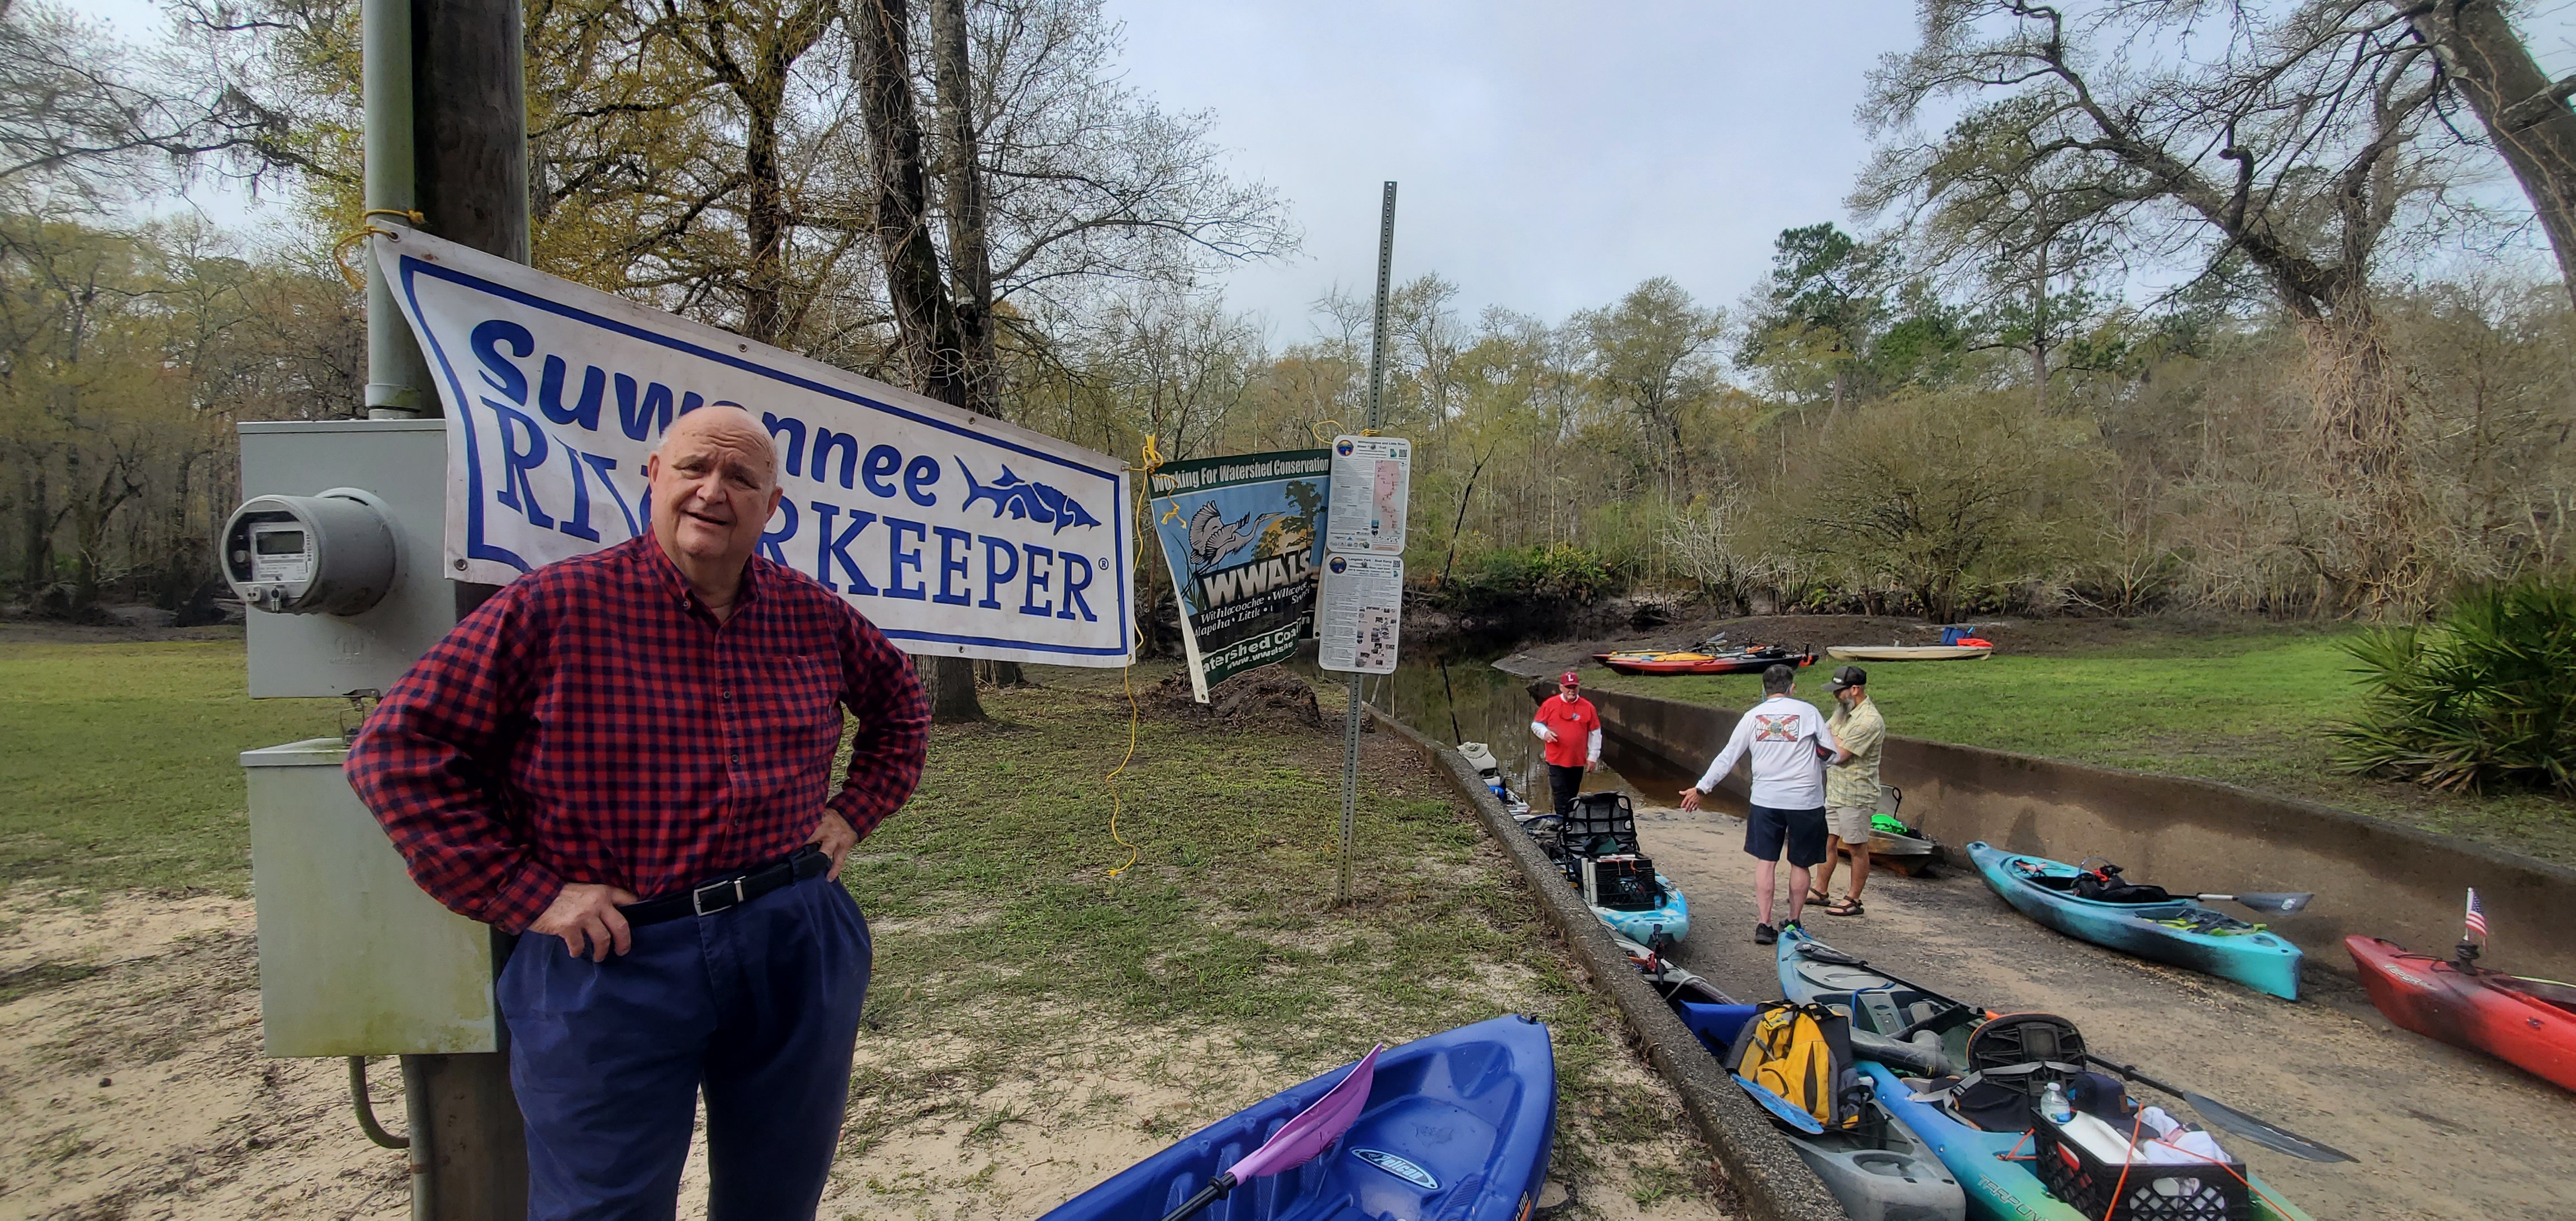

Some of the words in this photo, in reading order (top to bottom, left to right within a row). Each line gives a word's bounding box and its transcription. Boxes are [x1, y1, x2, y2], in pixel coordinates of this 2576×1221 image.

[471, 320, 941, 507] Suwnnee
[1201, 467, 1216, 485] For
[1219, 460, 1273, 482] Watershed
[1274, 457, 1329, 474] Conservation
[1204, 550, 1310, 608] WWALS
[1237, 607, 1261, 622] Little
[1202, 636, 1271, 673] atershed
[1374, 1154, 1424, 1180] Pelican
